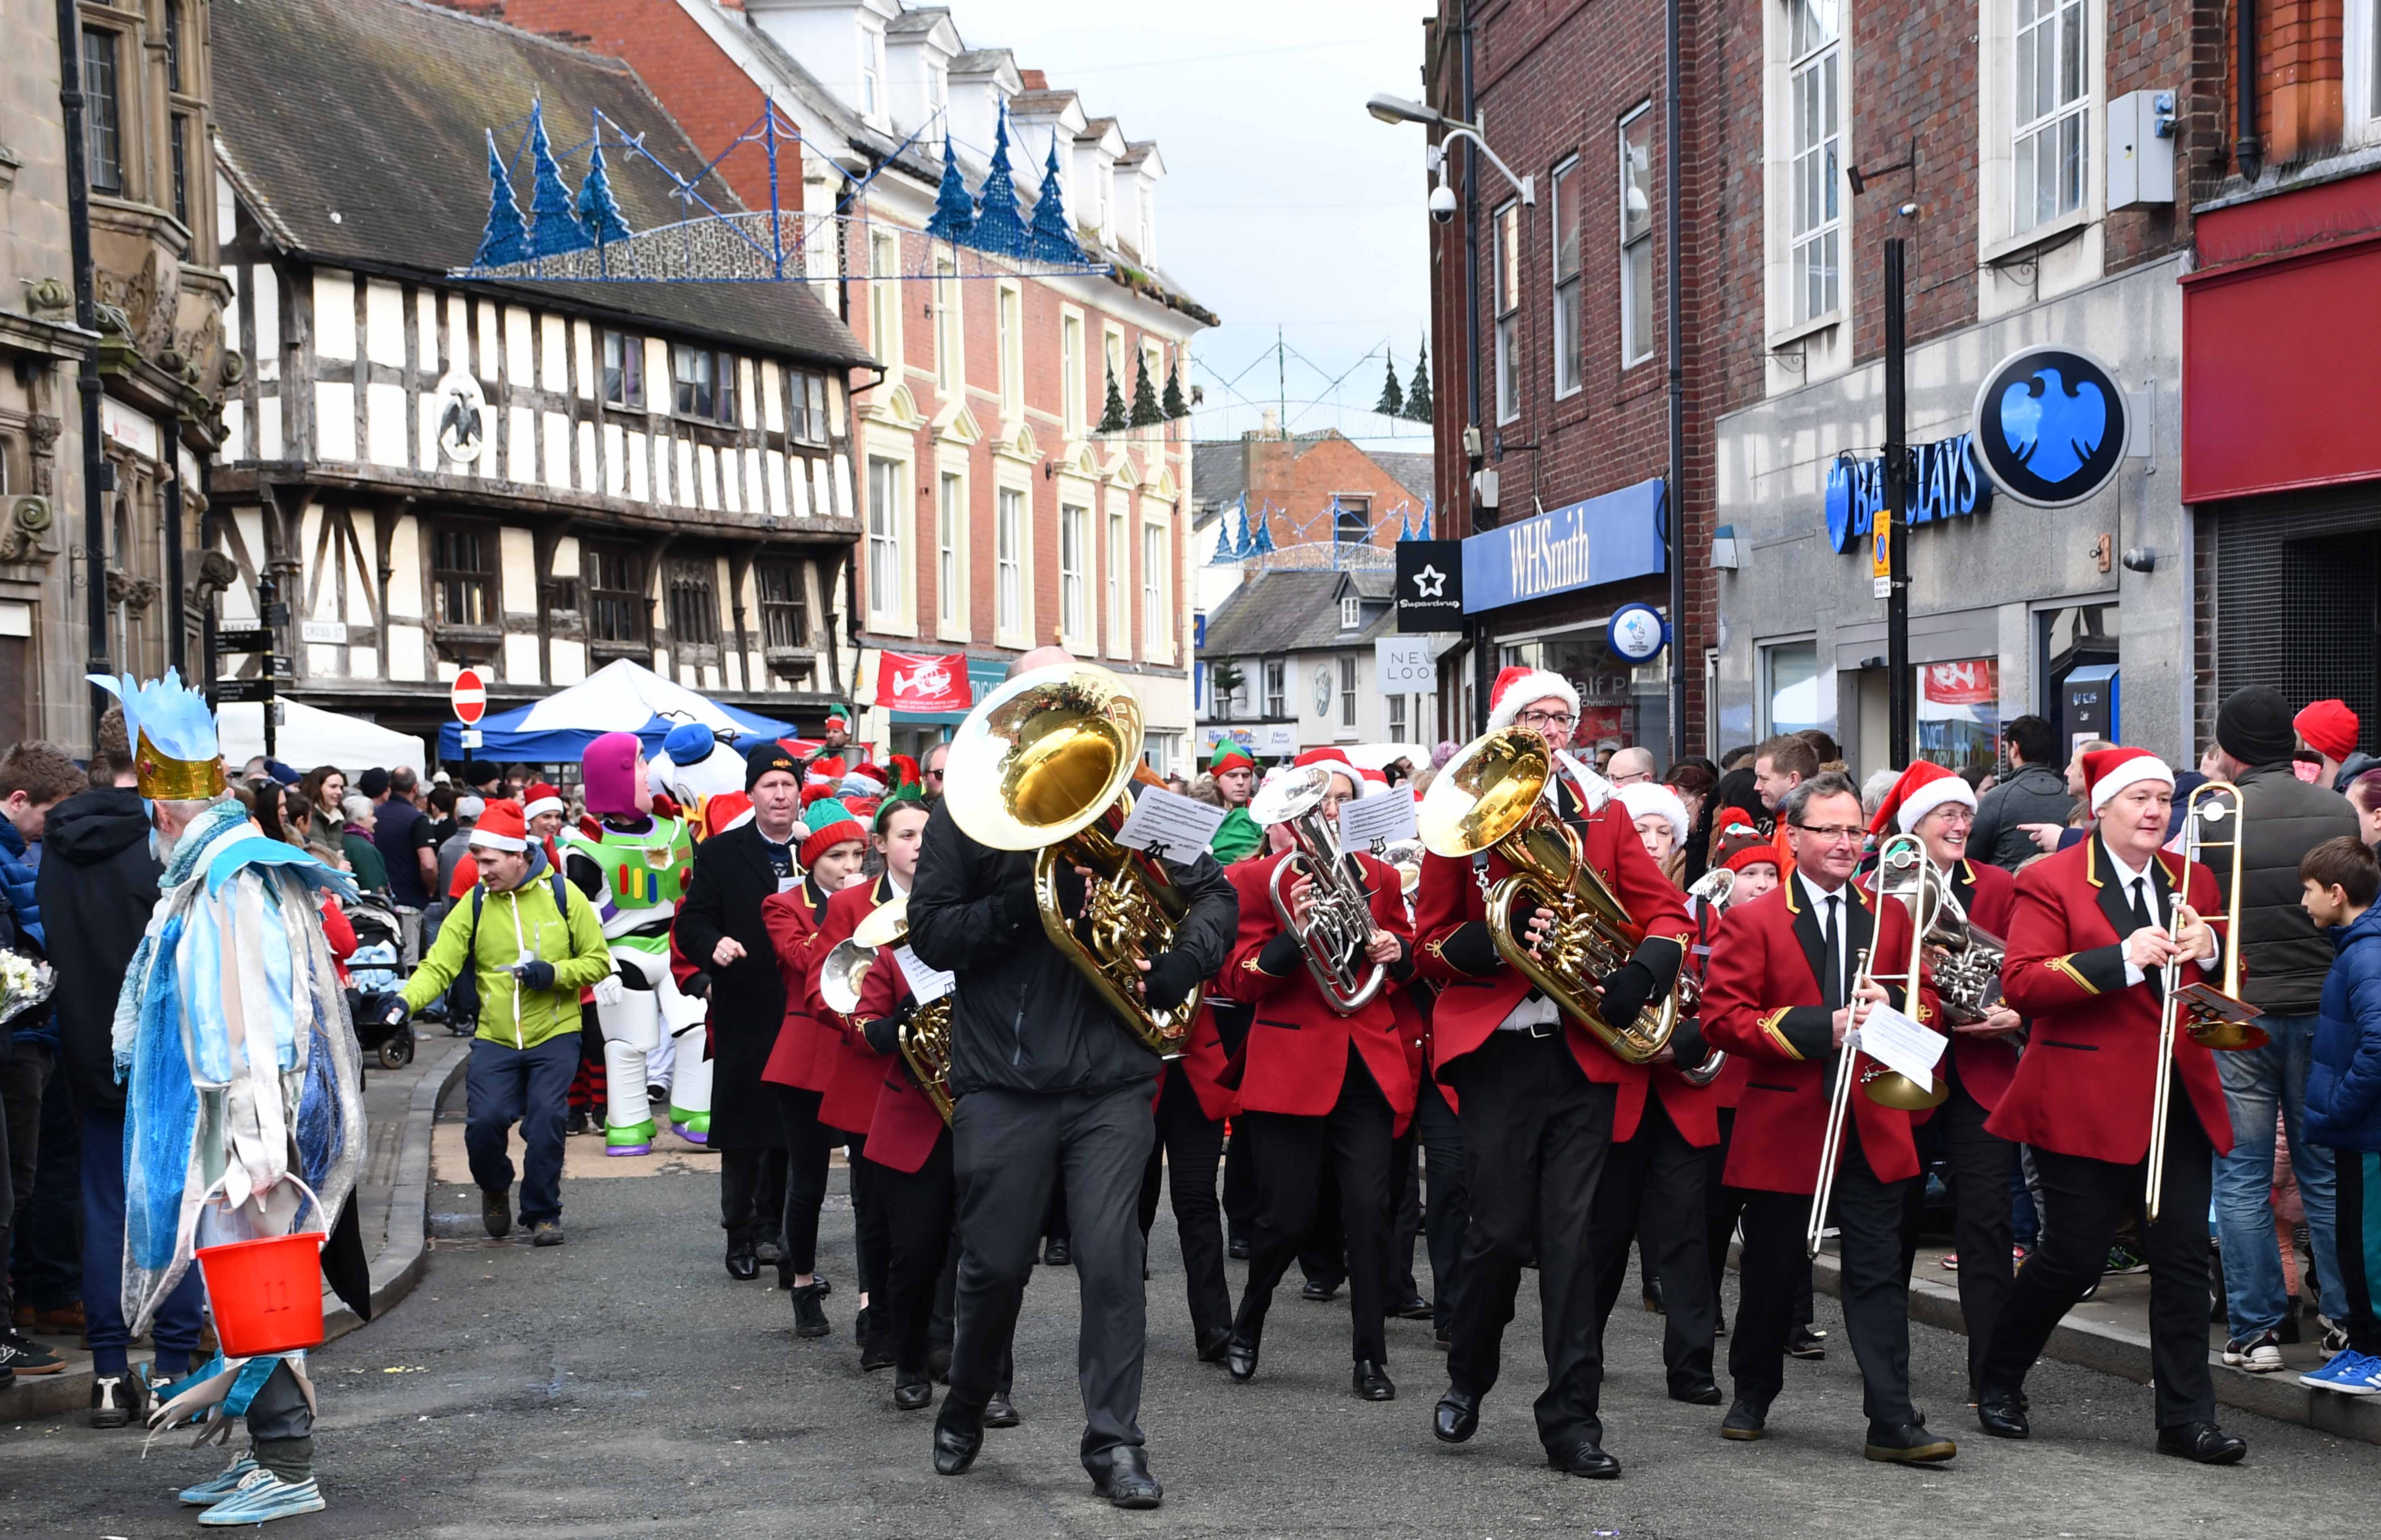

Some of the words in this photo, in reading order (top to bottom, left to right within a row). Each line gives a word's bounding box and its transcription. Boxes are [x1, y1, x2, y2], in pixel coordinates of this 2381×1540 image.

[1854, 431, 1976, 536] BACLAYS
[1509, 506, 1589, 599] WHSmith
[1400, 599, 1461, 609] Superdrug
[306, 626, 330, 638] CROSS
[1581, 699, 1623, 707] Christmas
